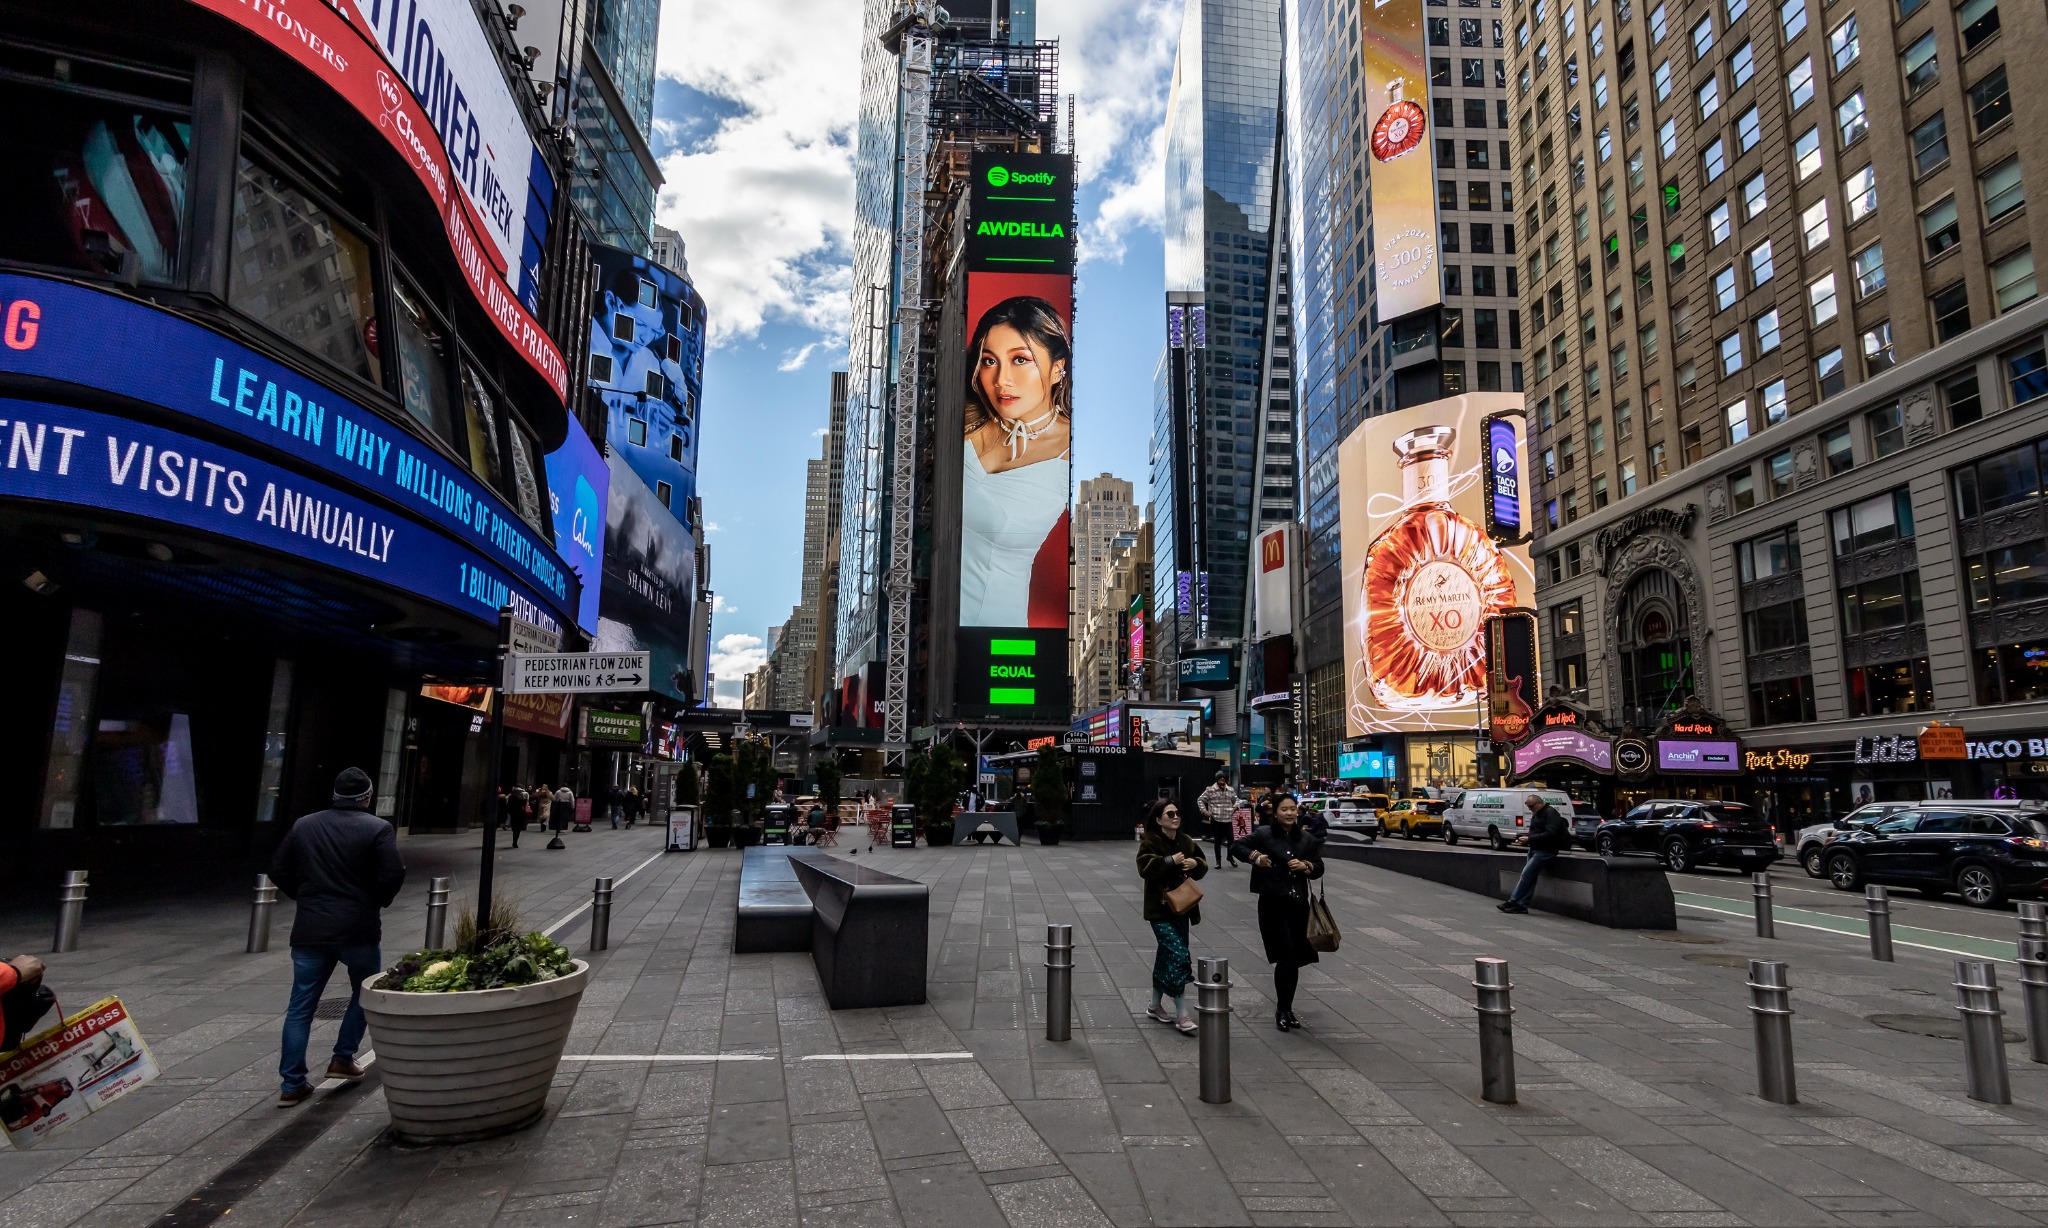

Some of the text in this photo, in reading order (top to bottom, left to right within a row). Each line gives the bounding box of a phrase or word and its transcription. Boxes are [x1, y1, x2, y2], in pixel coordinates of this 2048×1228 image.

[380, 75, 398, 105] We
[1011, 172, 1055, 186] Spotify
[482, 158, 513, 244] WEEK
[976, 221, 1065, 238] AWDELLA
[1390, 246, 1422, 270] 300
[1392, 243, 1435, 287] ANNIVERSARY
[450, 200, 485, 296] NATIONAL
[487, 277, 522, 340] NURSE
[210, 357, 325, 447] LEARN
[335, 415, 391, 477] WHY
[396, 448, 472, 526] MILLIONS
[475, 502, 490, 538] OF
[491, 515, 532, 571] PATIENTS
[531, 547, 556, 593] CHOOSE
[1495, 474, 1516, 490] TACO
[107, 435, 248, 516] VISITS
[257, 482, 394, 564] ANNUALLY
[1497, 484, 1517, 499] BELL
[572, 507, 594, 557] Calm
[460, 562, 467, 594] 1
[469, 566, 508, 612] BILLION
[510, 590, 537, 625] PATIENT
[628, 569, 654, 602] SHAWN
[656, 591, 673, 615] LEVY
[1438, 593, 1471, 604] MARTIN
[1428, 609, 1462, 632] XO
[525, 656, 643, 672] PEDESTRIAN FLOW ZONE
[990, 665, 1035, 678] EQUAL
[524, 674, 591, 689] KEEP MOVING
[1293, 682, 1302, 725] SQUARE
[1494, 716, 1512, 725] Hard
[1546, 711, 1576, 726] Hard Rock
[1674, 723, 1713, 735] Hard Rock
[594, 726, 630, 736] COFFEE
[1132, 717, 1141, 747] BAR
[1089, 746, 1127, 754] HOTDOGS
[1668, 752, 1695, 760] Anchin
[1745, 749, 1809, 770] Rock Shop
[1855, 735, 1917, 764] Lids
[1966, 739, 2022, 760] TACO
[30, 1023, 86, 1060] Hop-Off
[86, 1008, 120, 1031] Pass
[97, 1078, 126, 1096] Included:
[100, 1076, 142, 1102] Liberty Cruise
